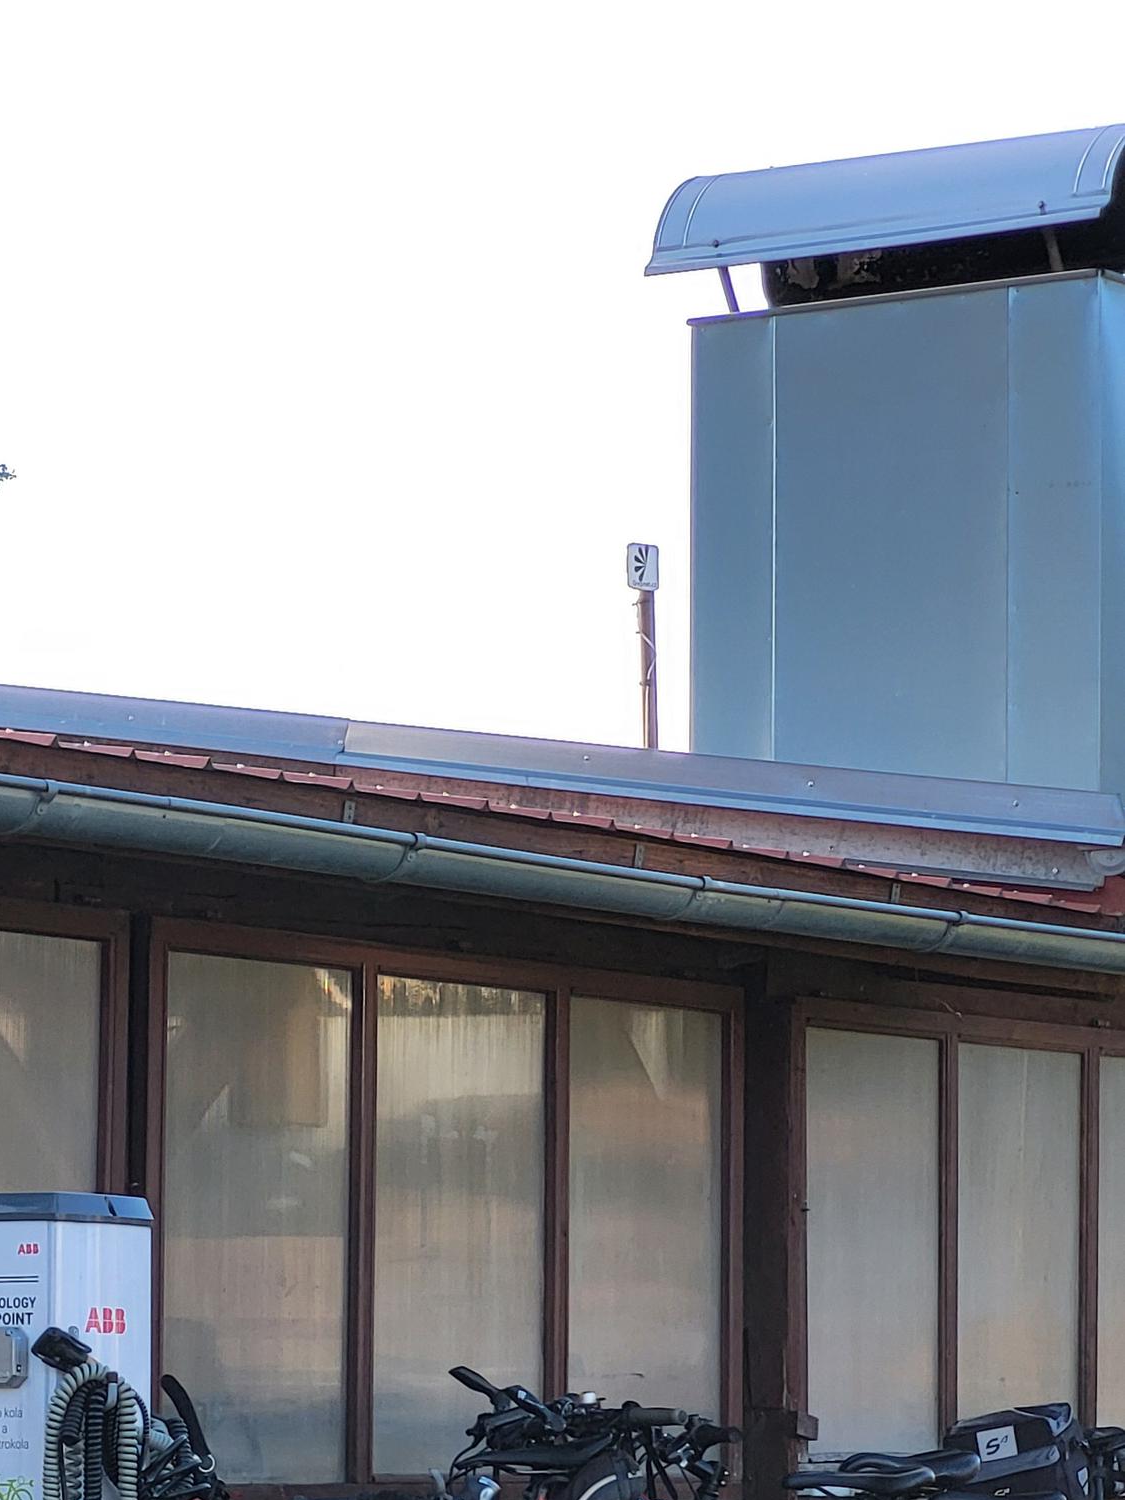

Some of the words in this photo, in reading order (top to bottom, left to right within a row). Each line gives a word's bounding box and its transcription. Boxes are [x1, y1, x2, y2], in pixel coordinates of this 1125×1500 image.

[18, 1243, 39, 1255] ABB
[85, 1307, 126, 1334] ABB
[4, 1406, 23, 1418] kola
[2, 1425, 8, 1434] a
